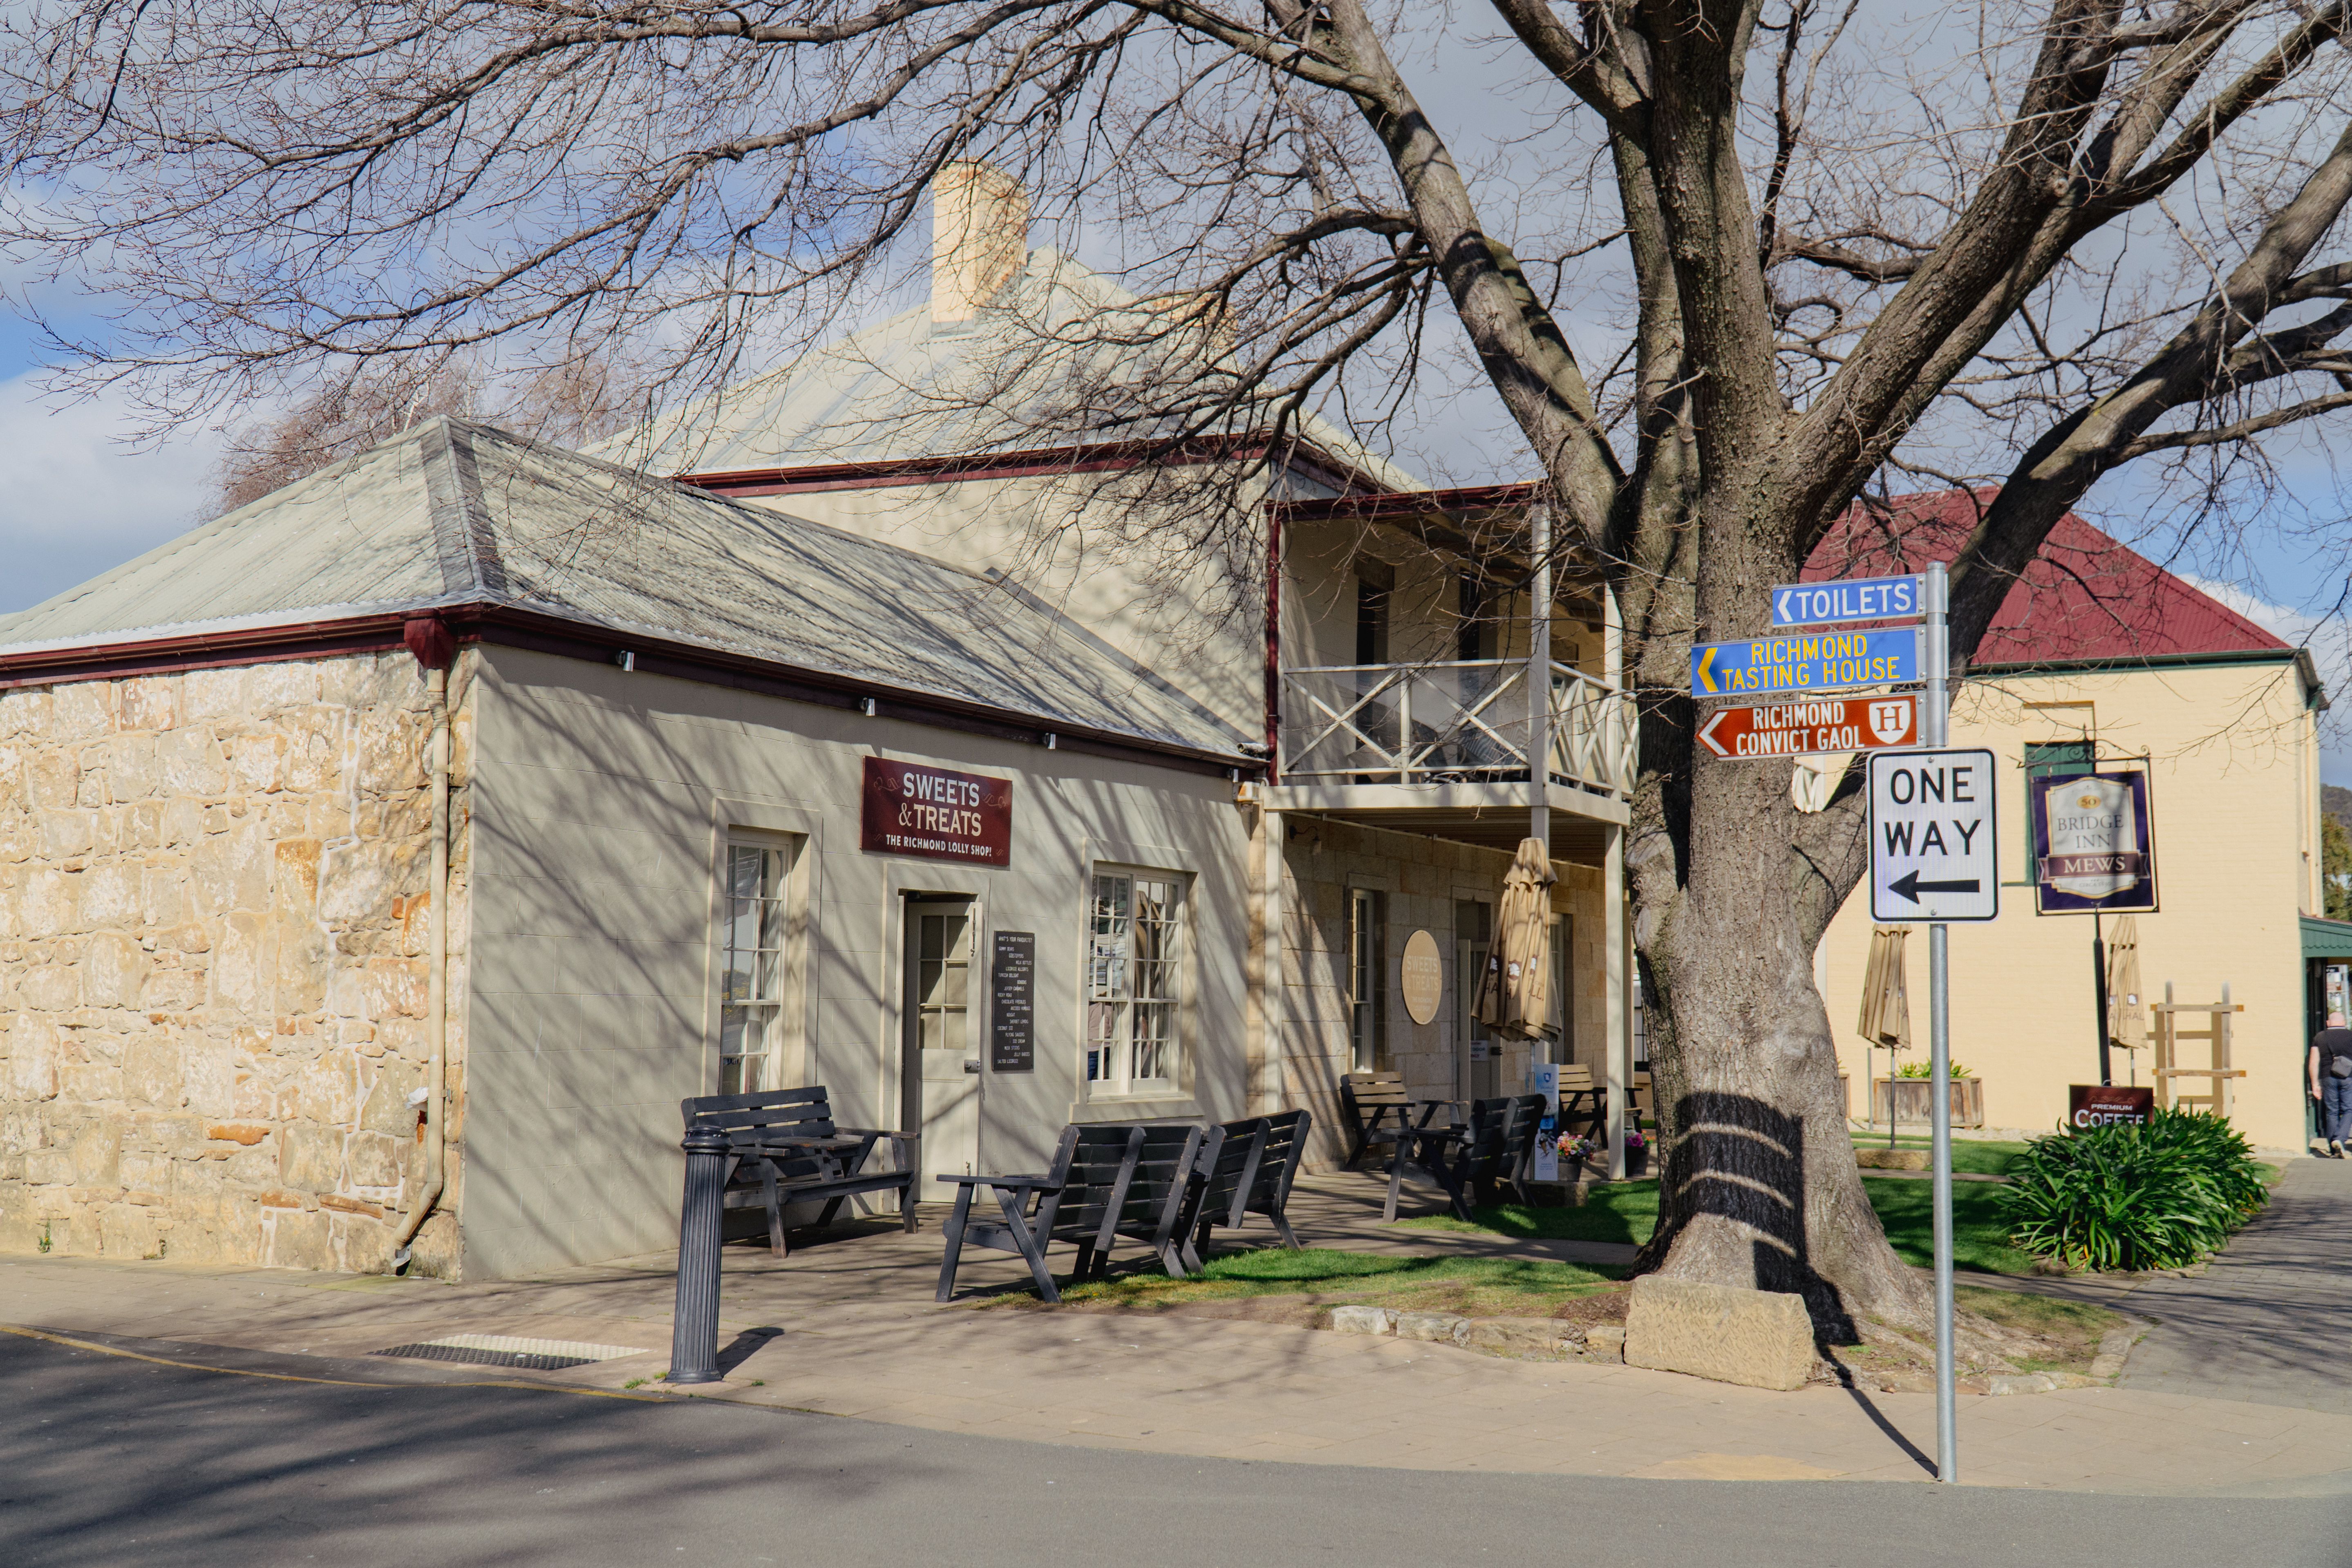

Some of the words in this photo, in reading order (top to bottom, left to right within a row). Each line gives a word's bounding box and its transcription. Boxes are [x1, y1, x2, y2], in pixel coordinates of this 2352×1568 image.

[1796, 583, 1911, 619] TOILETS
[1751, 635, 1867, 664] RICHMOND
[1721, 663, 1810, 691] TASTING
[1823, 656, 1900, 683] HOUSE
[1752, 701, 1845, 730] RICHMOND
[1876, 705, 1903, 732] H
[1736, 729, 1810, 756] CONVICT
[1817, 725, 1865, 751] GAOL
[902, 772, 980, 807] SWEETS
[1890, 766, 1974, 805] ONE
[898, 802, 912, 827] &
[913, 803, 982, 837] TREATS
[2057, 814, 2124, 831] BRIDGE
[886, 834, 901, 846] THE
[903, 836, 946, 851] RICHMOND
[948, 841, 969, 854] LOLLY
[971, 844, 992, 857] SHOP!
[1884, 819, 1981, 857] WAY
[2076, 833, 2111, 848] INN
[2064, 856, 2126, 874] MEWS
[1407, 955, 1438, 973] SWEETS
